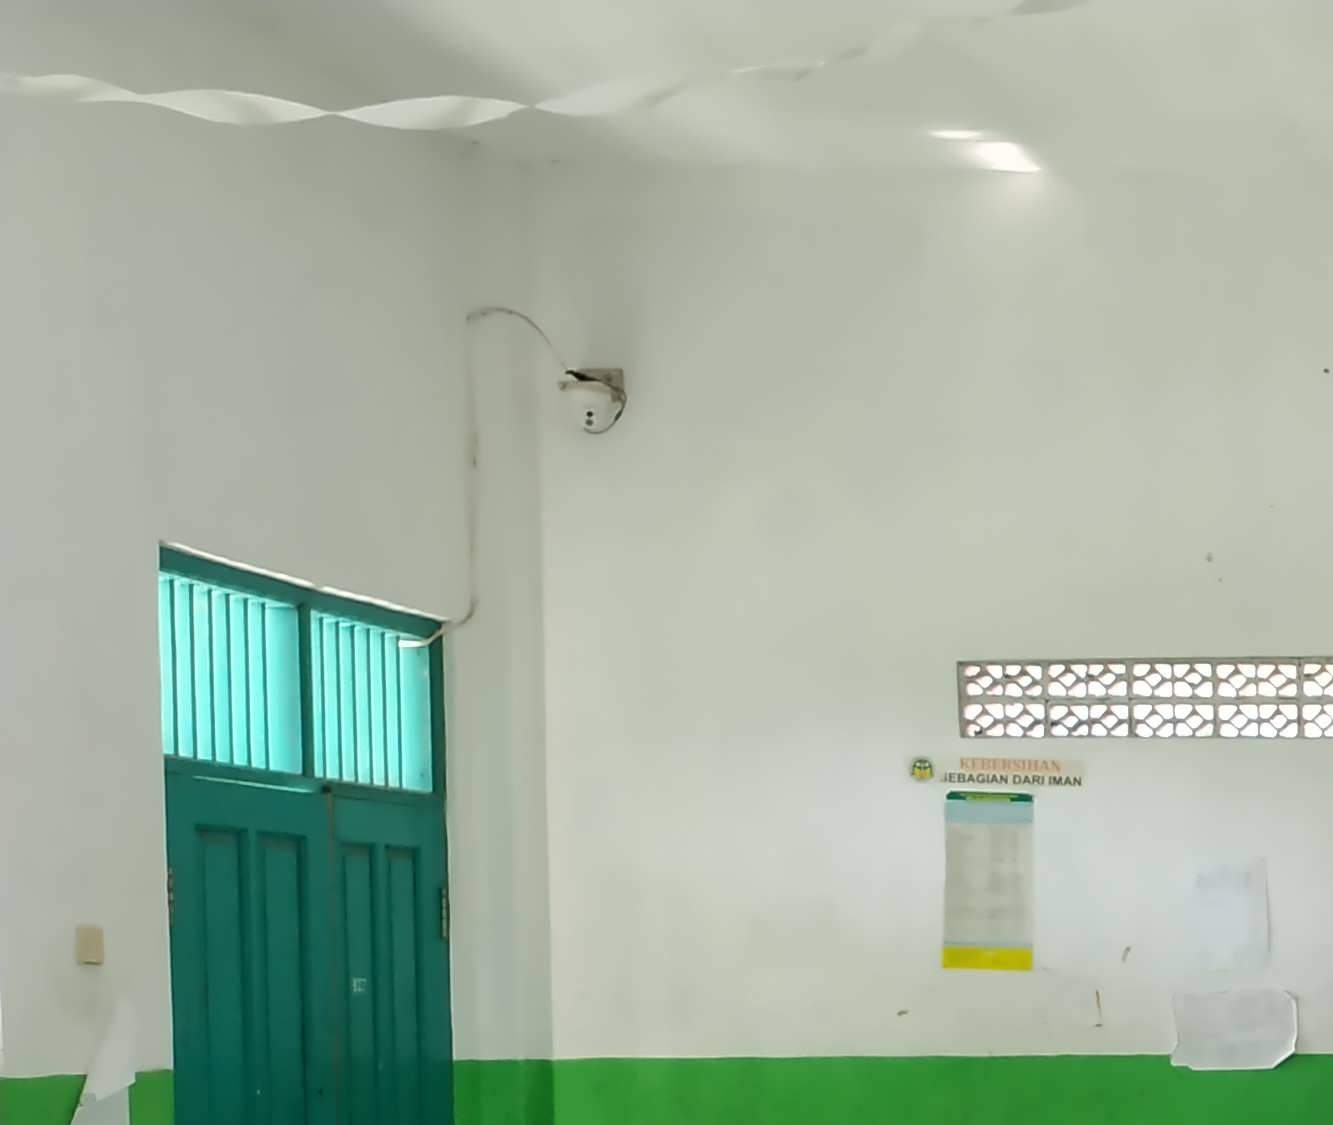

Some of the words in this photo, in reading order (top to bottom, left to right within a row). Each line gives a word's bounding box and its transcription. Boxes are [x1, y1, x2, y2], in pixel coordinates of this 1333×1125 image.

[959, 758, 1061, 772] KEBERSIHAN
[1012, 773, 1045, 786] DARI
[1048, 774, 1083, 787] IMAN
